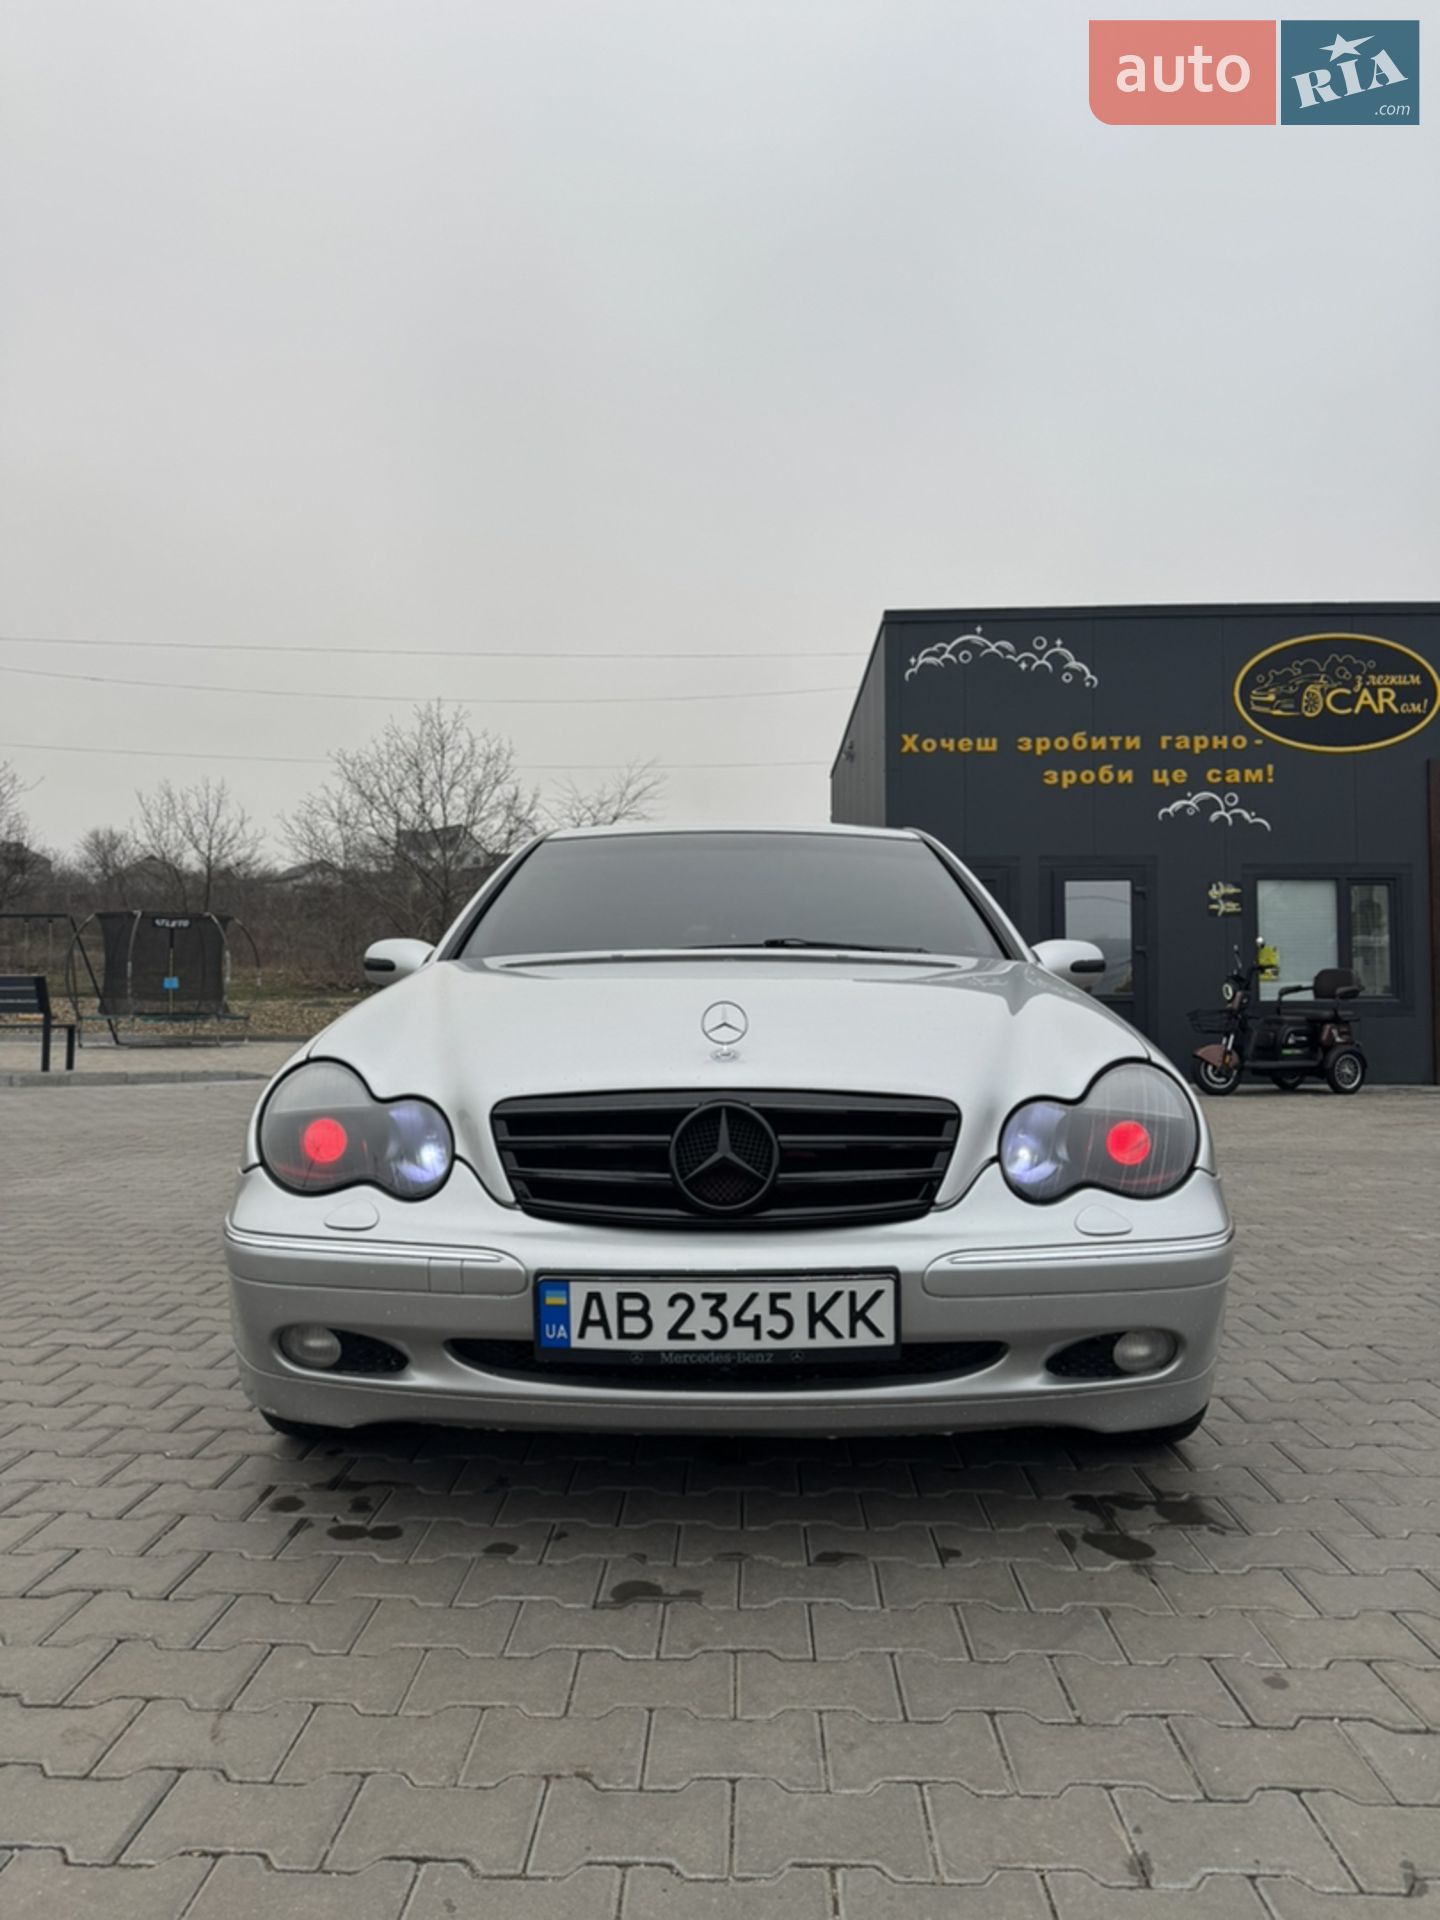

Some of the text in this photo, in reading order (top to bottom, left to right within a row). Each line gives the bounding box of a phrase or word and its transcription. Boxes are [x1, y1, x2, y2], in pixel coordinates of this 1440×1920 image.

[1366, 674, 1421, 686] легким
[901, 734, 998, 753] Хочеш
[1017, 733, 1142, 755] зробити
[1043, 765, 1275, 788] зроби це сам!
[545, 1324, 568, 1339] UA
[660, 1351, 774, 1364] Mercedes-Benz
